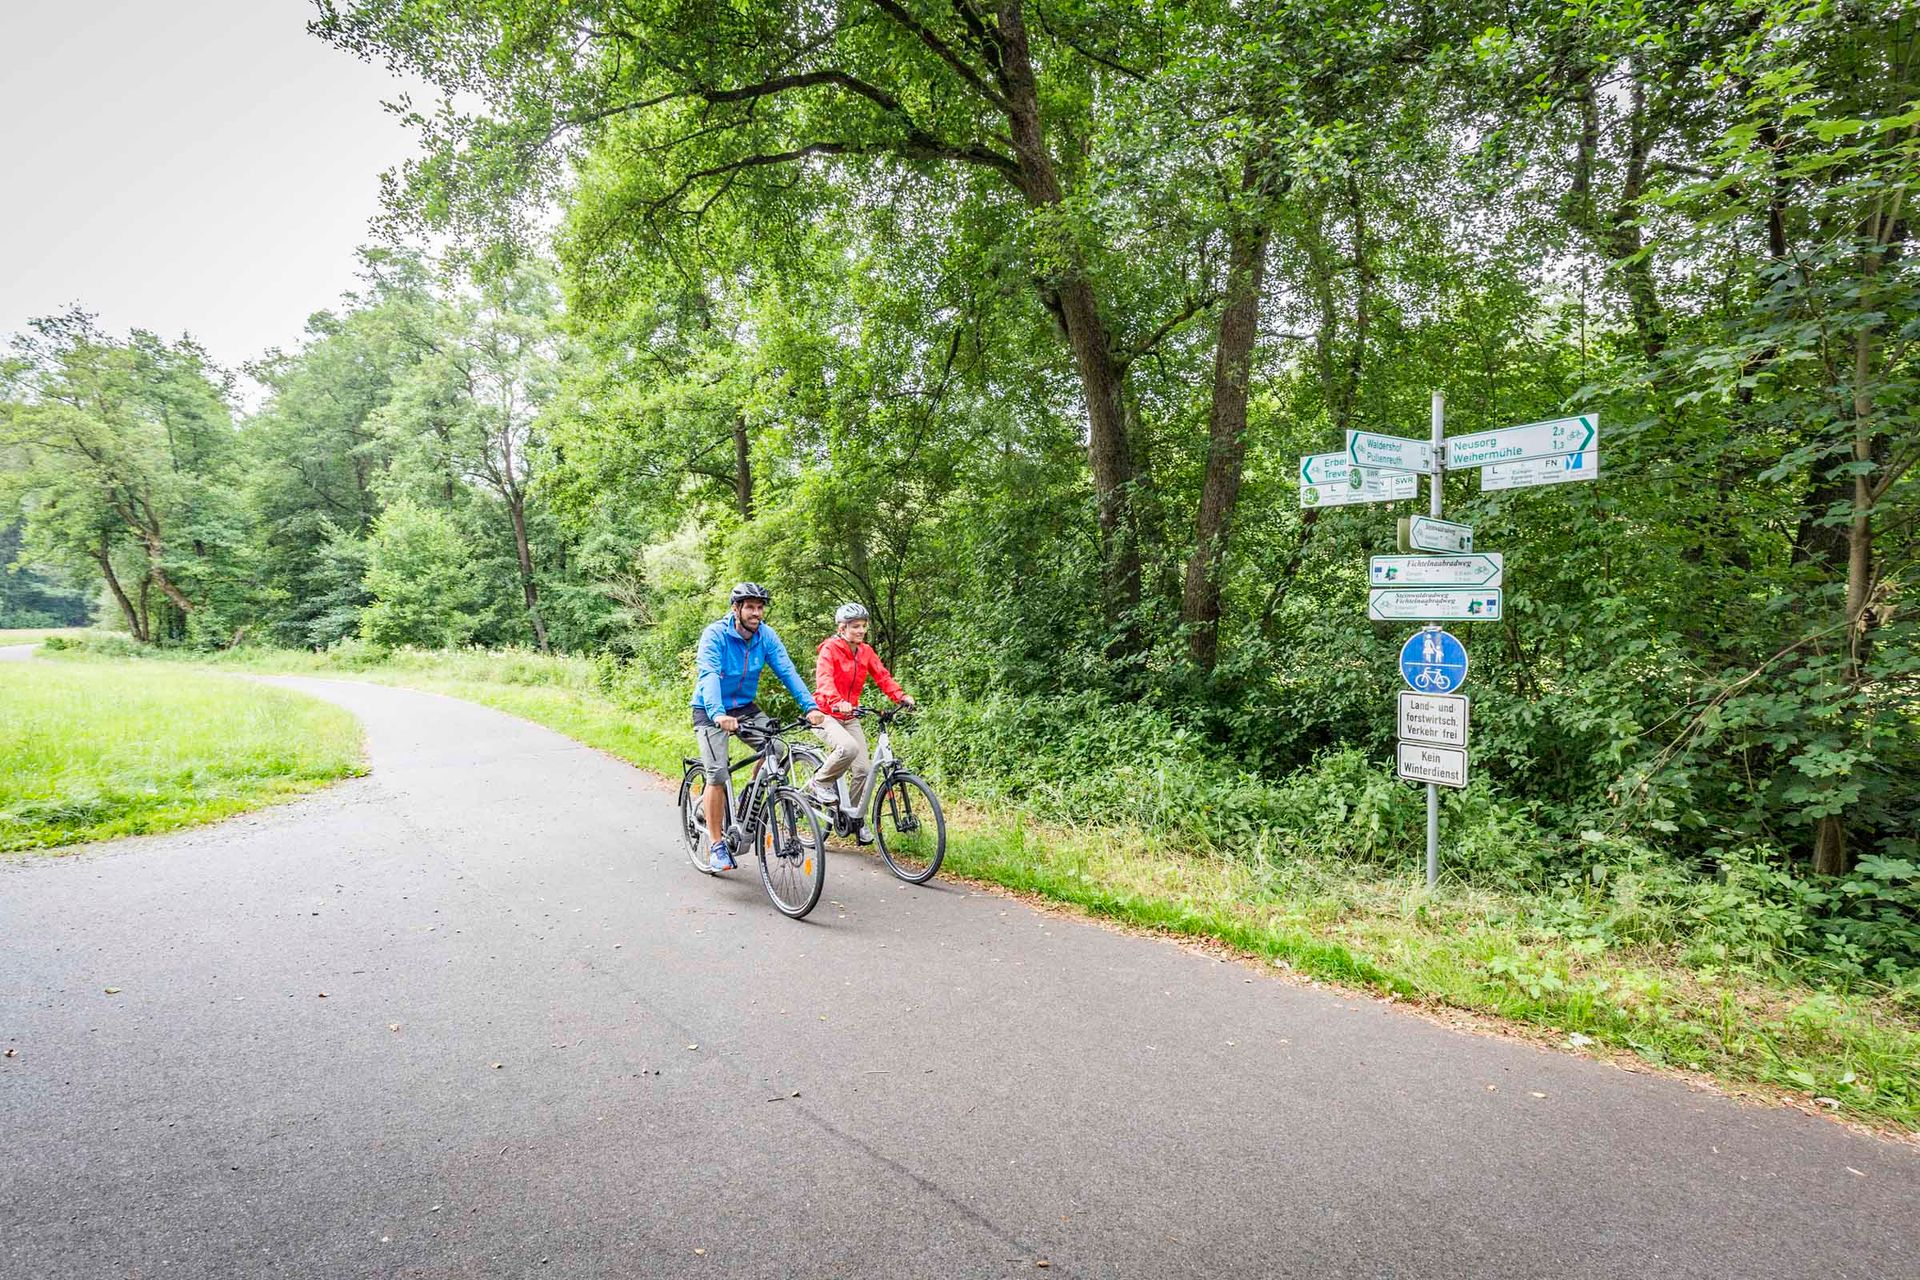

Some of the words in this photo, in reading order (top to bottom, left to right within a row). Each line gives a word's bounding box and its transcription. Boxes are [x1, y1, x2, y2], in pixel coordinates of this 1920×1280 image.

[1454, 438, 1496, 450] Neusorg
[1454, 447, 1522, 463] Weihermühle
[1545, 456, 1557, 467] FN
[1395, 477, 1413, 485] SWR
[1410, 700, 1434, 710] Land-
[1438, 702, 1454, 712] und
[1406, 713, 1458, 727] forstwirtsch.
[1407, 725, 1438, 737] Verkehr
[1443, 729, 1457, 739] frei
[1421, 751, 1440, 763] Kein
[1404, 762, 1459, 780] Winterdienst
